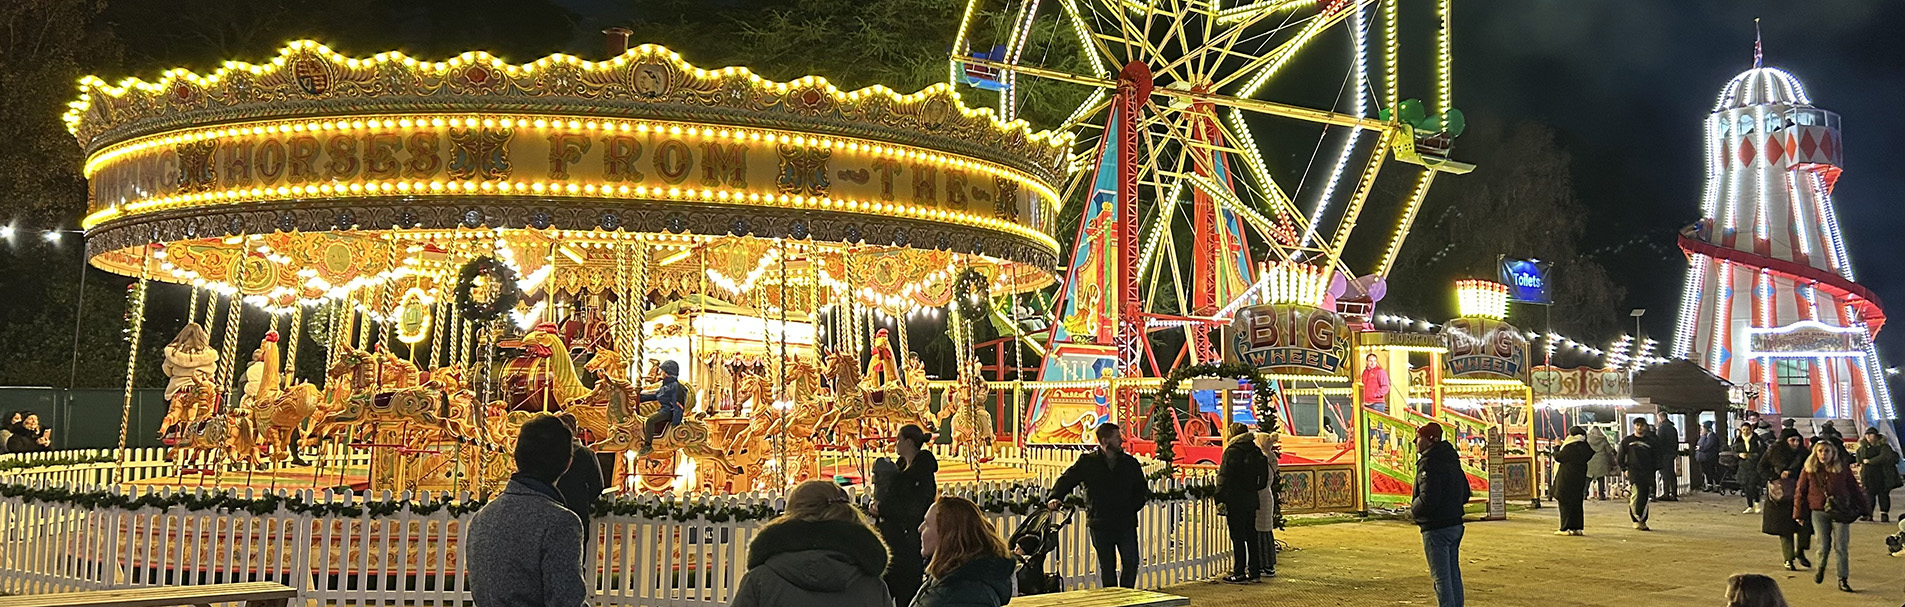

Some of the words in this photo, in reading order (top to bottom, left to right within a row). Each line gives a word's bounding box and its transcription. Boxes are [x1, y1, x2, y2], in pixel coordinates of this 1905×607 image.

[221, 133, 441, 185] HORSES
[547, 132, 749, 189] FROM
[1513, 272, 1541, 288] Toilets
[1249, 304, 1334, 351] BIG
[1450, 319, 1513, 359] BIG
[1249, 349, 1333, 371] WHEEL
[1453, 357, 1514, 376] WHEEL
